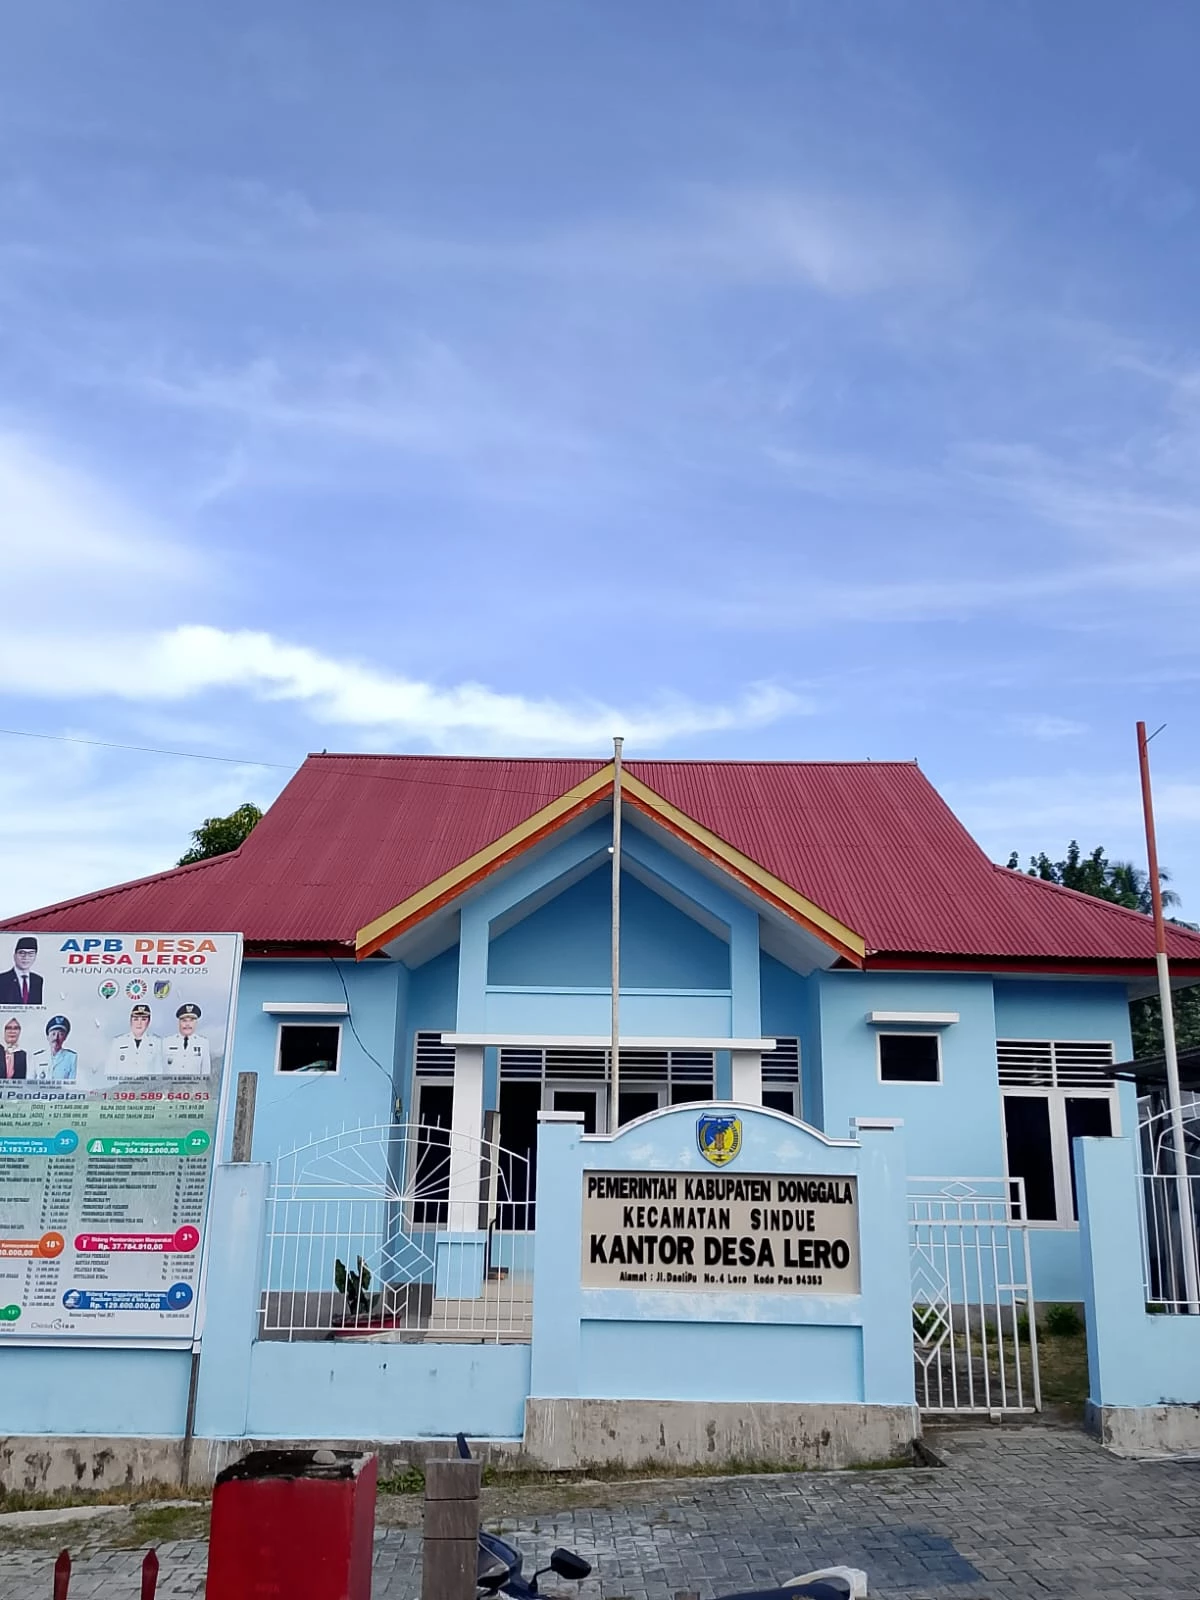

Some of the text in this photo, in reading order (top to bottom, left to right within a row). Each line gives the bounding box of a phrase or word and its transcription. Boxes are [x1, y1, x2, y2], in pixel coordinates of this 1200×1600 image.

[60, 939, 217, 953] APB DESA
[68, 955, 206, 965] DESA LERO
[105, 967, 176, 975] ANGGARAN
[7, 1091, 86, 1101] Pendapatan
[588, 1177, 853, 1205] PEMERINTAH KABUPATEN DONGGALA
[623, 1206, 815, 1231] KECAMATAN SINDUE
[590, 1235, 850, 1269] KANTOR DESA LERO
[620, 1271, 647, 1282] Alamat
[754, 1274, 774, 1285] Kode
